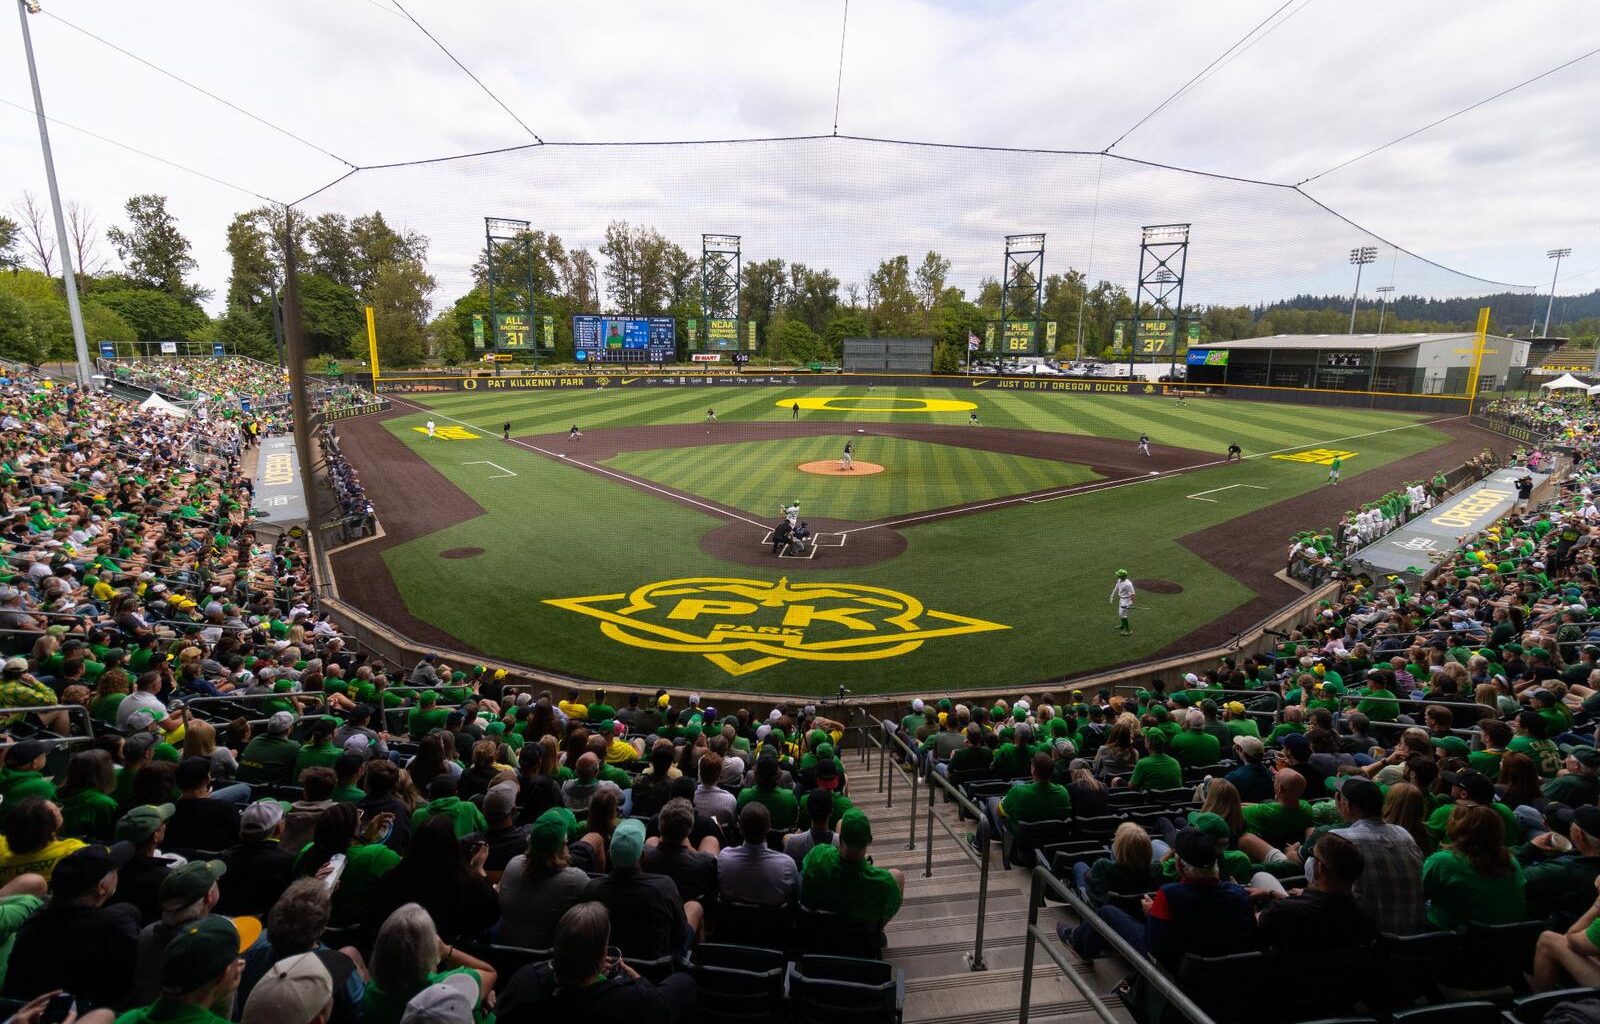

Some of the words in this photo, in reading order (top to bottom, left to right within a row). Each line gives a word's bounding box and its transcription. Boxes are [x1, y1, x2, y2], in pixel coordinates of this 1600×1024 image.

[506, 316, 523, 324] ALL
[1146, 322, 1166, 330] MLB
[1012, 323, 1028, 331] MLB
[507, 332, 523, 345] 31
[1010, 338, 1027, 350] 82
[1143, 339, 1165, 352] 37
[463, 379, 477, 390] O
[488, 380, 506, 388] PAT
[510, 379, 557, 387] KILKENNY
[561, 378, 584, 386] PARK
[998, 380, 1019, 388] JUST
[1052, 382, 1091, 391] OREGON
[1096, 384, 1128, 392] DUCKS
[325, 407, 359, 420] FIGHTING
[362, 404, 382, 414] DUCKS
[1508, 426, 1530, 440] OREGON
[1431, 489, 1514, 527] OREGON
[714, 624, 804, 636] PARK
